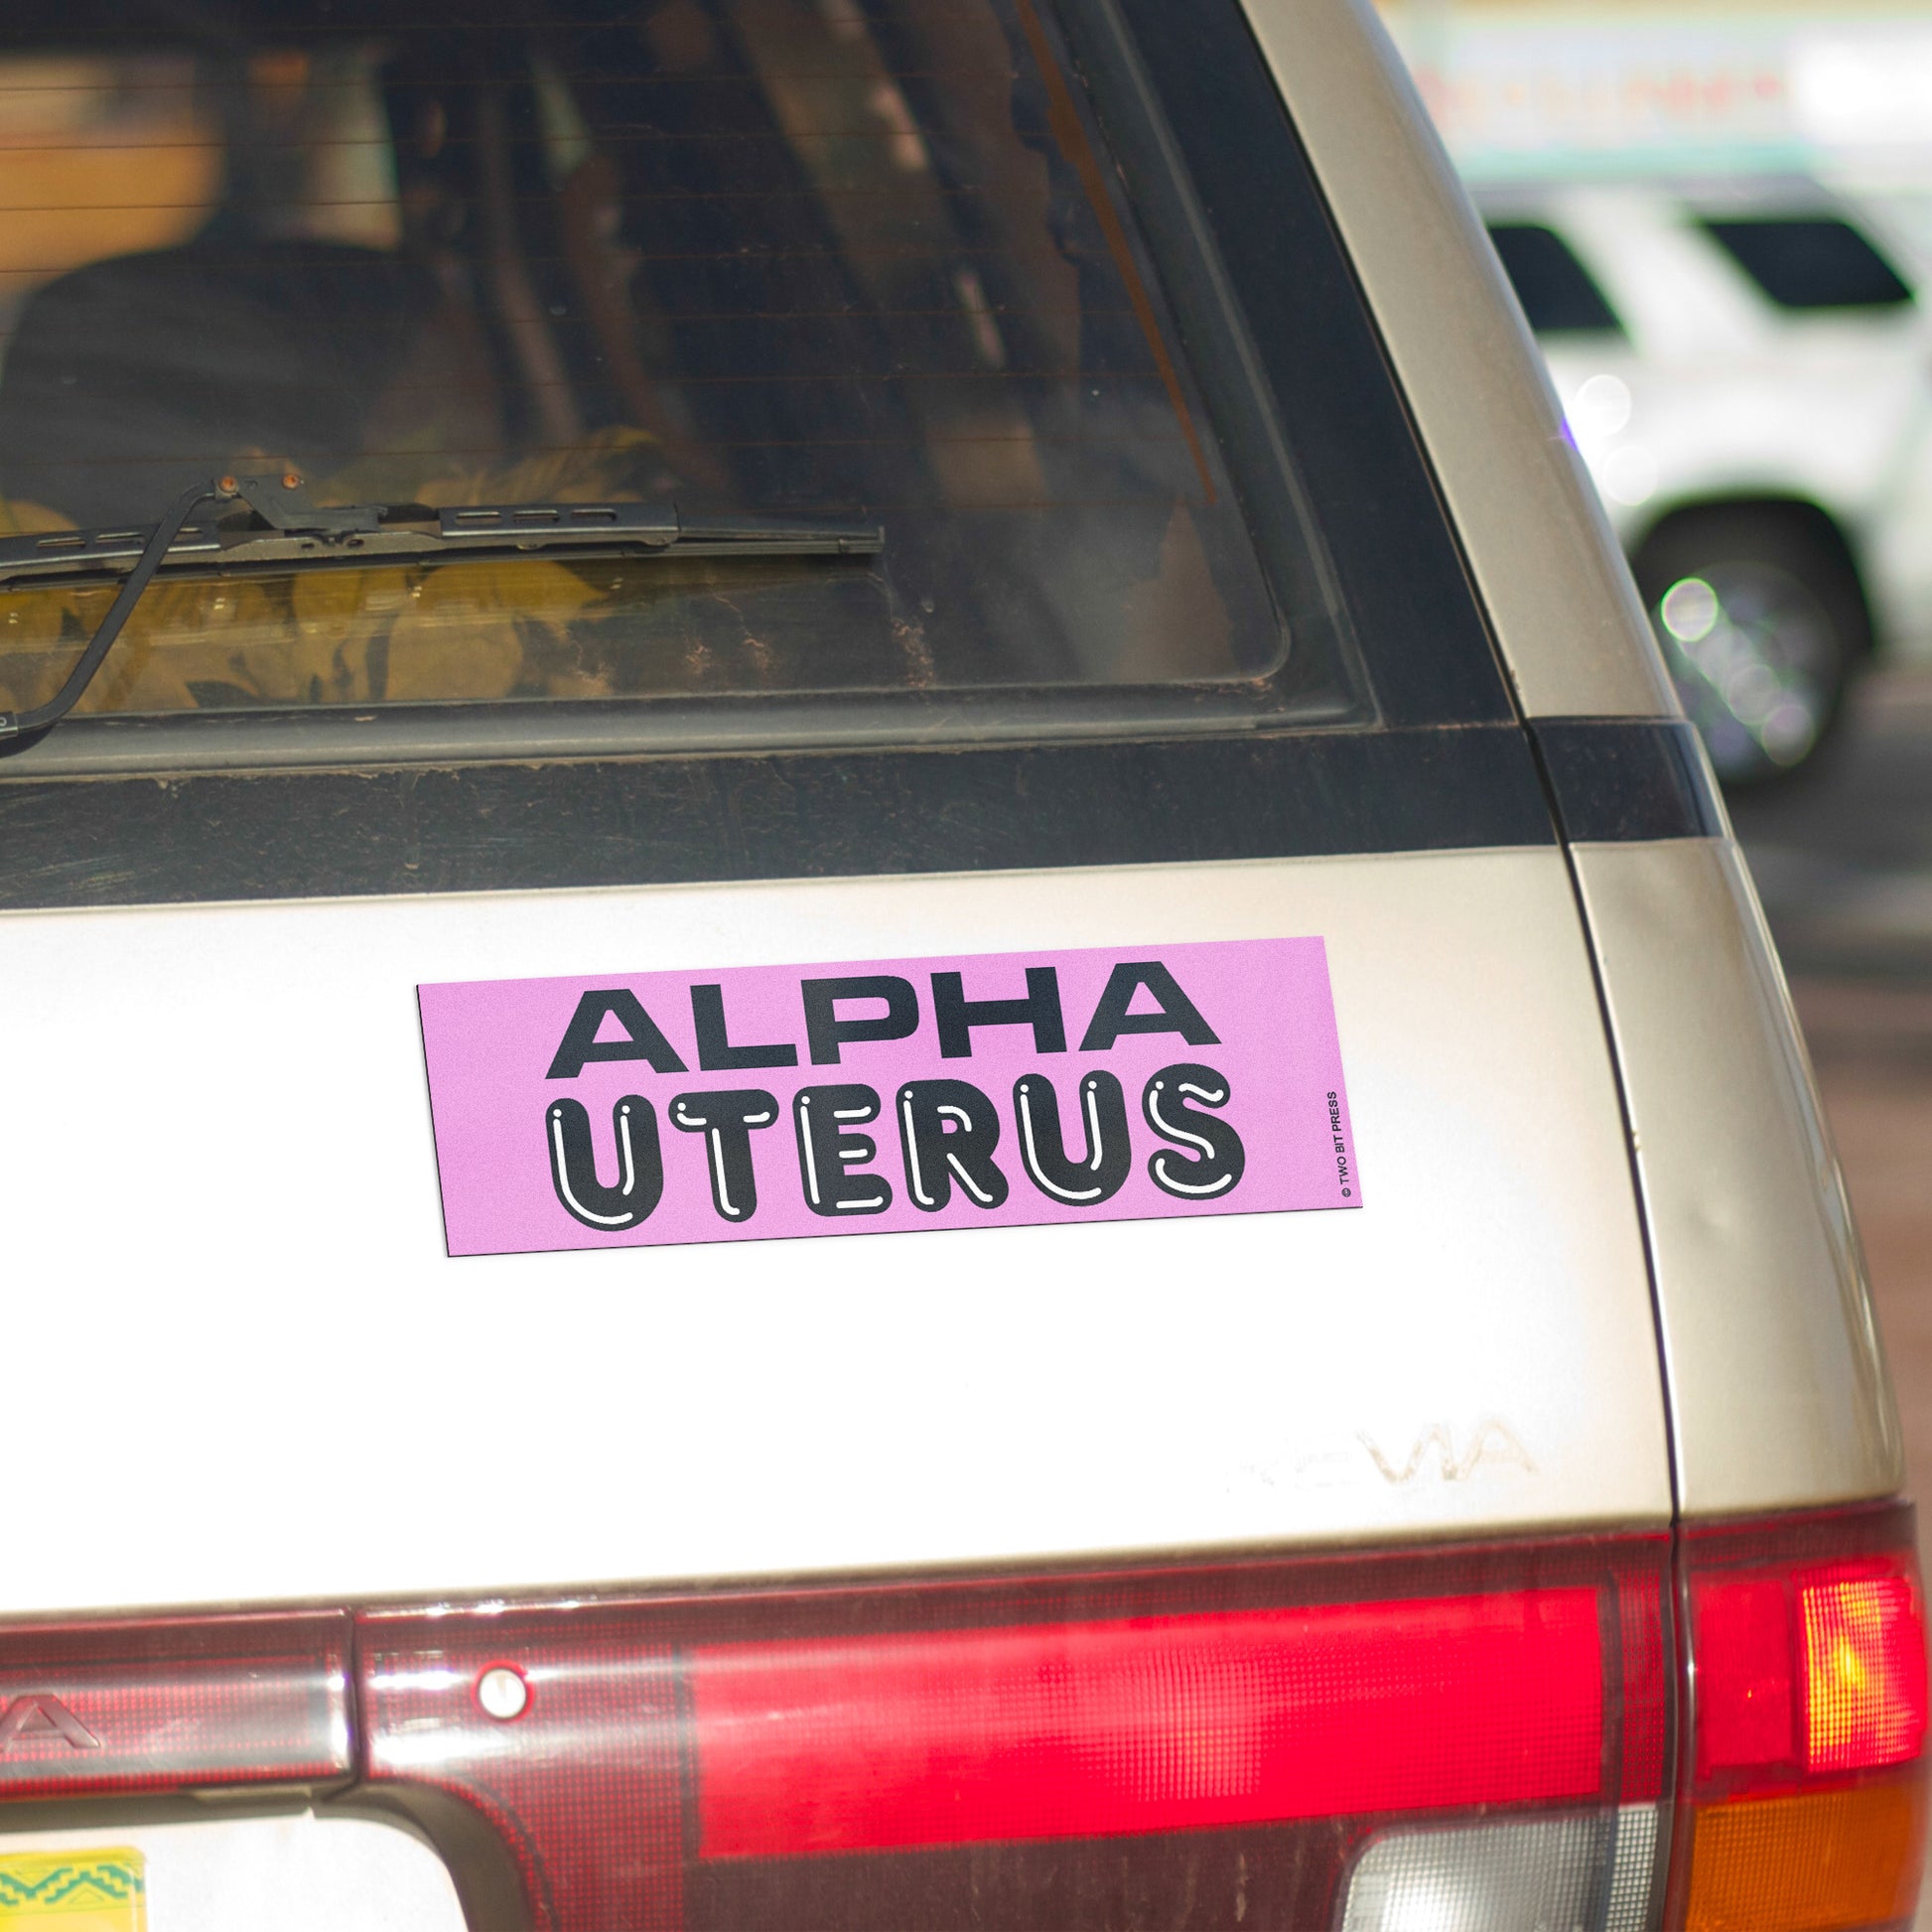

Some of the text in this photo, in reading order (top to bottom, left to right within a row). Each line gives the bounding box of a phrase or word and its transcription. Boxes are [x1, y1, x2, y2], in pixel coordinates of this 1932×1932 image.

[545, 961, 1222, 1080] ALPHA
[1327, 1091, 1341, 1132] PRESS
[545, 1063, 1246, 1232] UTERUS
[1333, 1135, 1345, 1153] BIT
[1336, 1156, 1349, 1184] TWO
